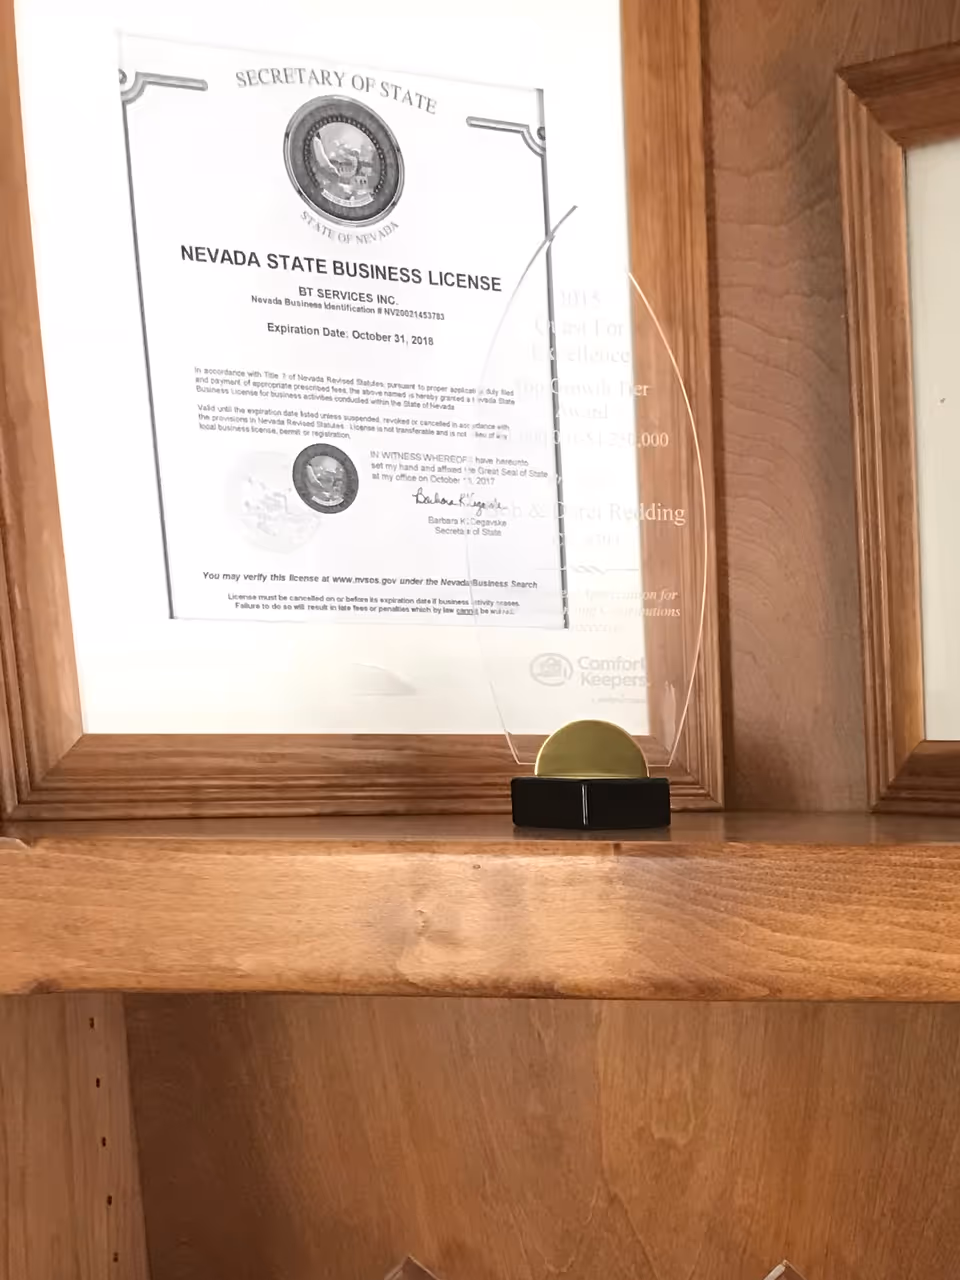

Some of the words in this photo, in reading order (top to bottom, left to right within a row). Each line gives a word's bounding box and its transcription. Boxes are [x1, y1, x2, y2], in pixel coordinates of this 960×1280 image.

[236, 68, 346, 89] SECRETARY
[351, 74, 376, 93] OF
[379, 82, 438, 115] STATE
[300, 210, 333, 239] STATE
[337, 233, 352, 245] OF
[355, 221, 400, 245] NEVADA
[180, 244, 261, 268] NEVADA
[267, 253, 328, 275] STATE
[333, 260, 423, 284] BUSINESS
[429, 270, 503, 293] LICENSE
[250, 295, 282, 307] Nevada
[284, 298, 323, 311] Business
[324, 301, 376, 315] Identification
[298, 286, 314, 297] BT
[317, 288, 374, 303] SERVICES
[376, 294, 399, 306] INC.
[267, 322, 321, 339] Expiration
[322, 327, 350, 339] Date:
[352, 330, 392, 343] October
[394, 334, 410, 347] 31,
[411, 335, 435, 346] 2018
[203, 571, 220, 580] You
[222, 573, 241, 582] may
[243, 573, 267, 582] verify
[270, 573, 286, 582] this
[289, 574, 320, 582] license
[400, 577, 423, 586] under
[425, 578, 438, 586] the
[440, 578, 471, 587] Nevada
[472, 579, 508, 588] Business
[511, 580, 538, 589] Search
[577, 656, 646, 672] Comfort
